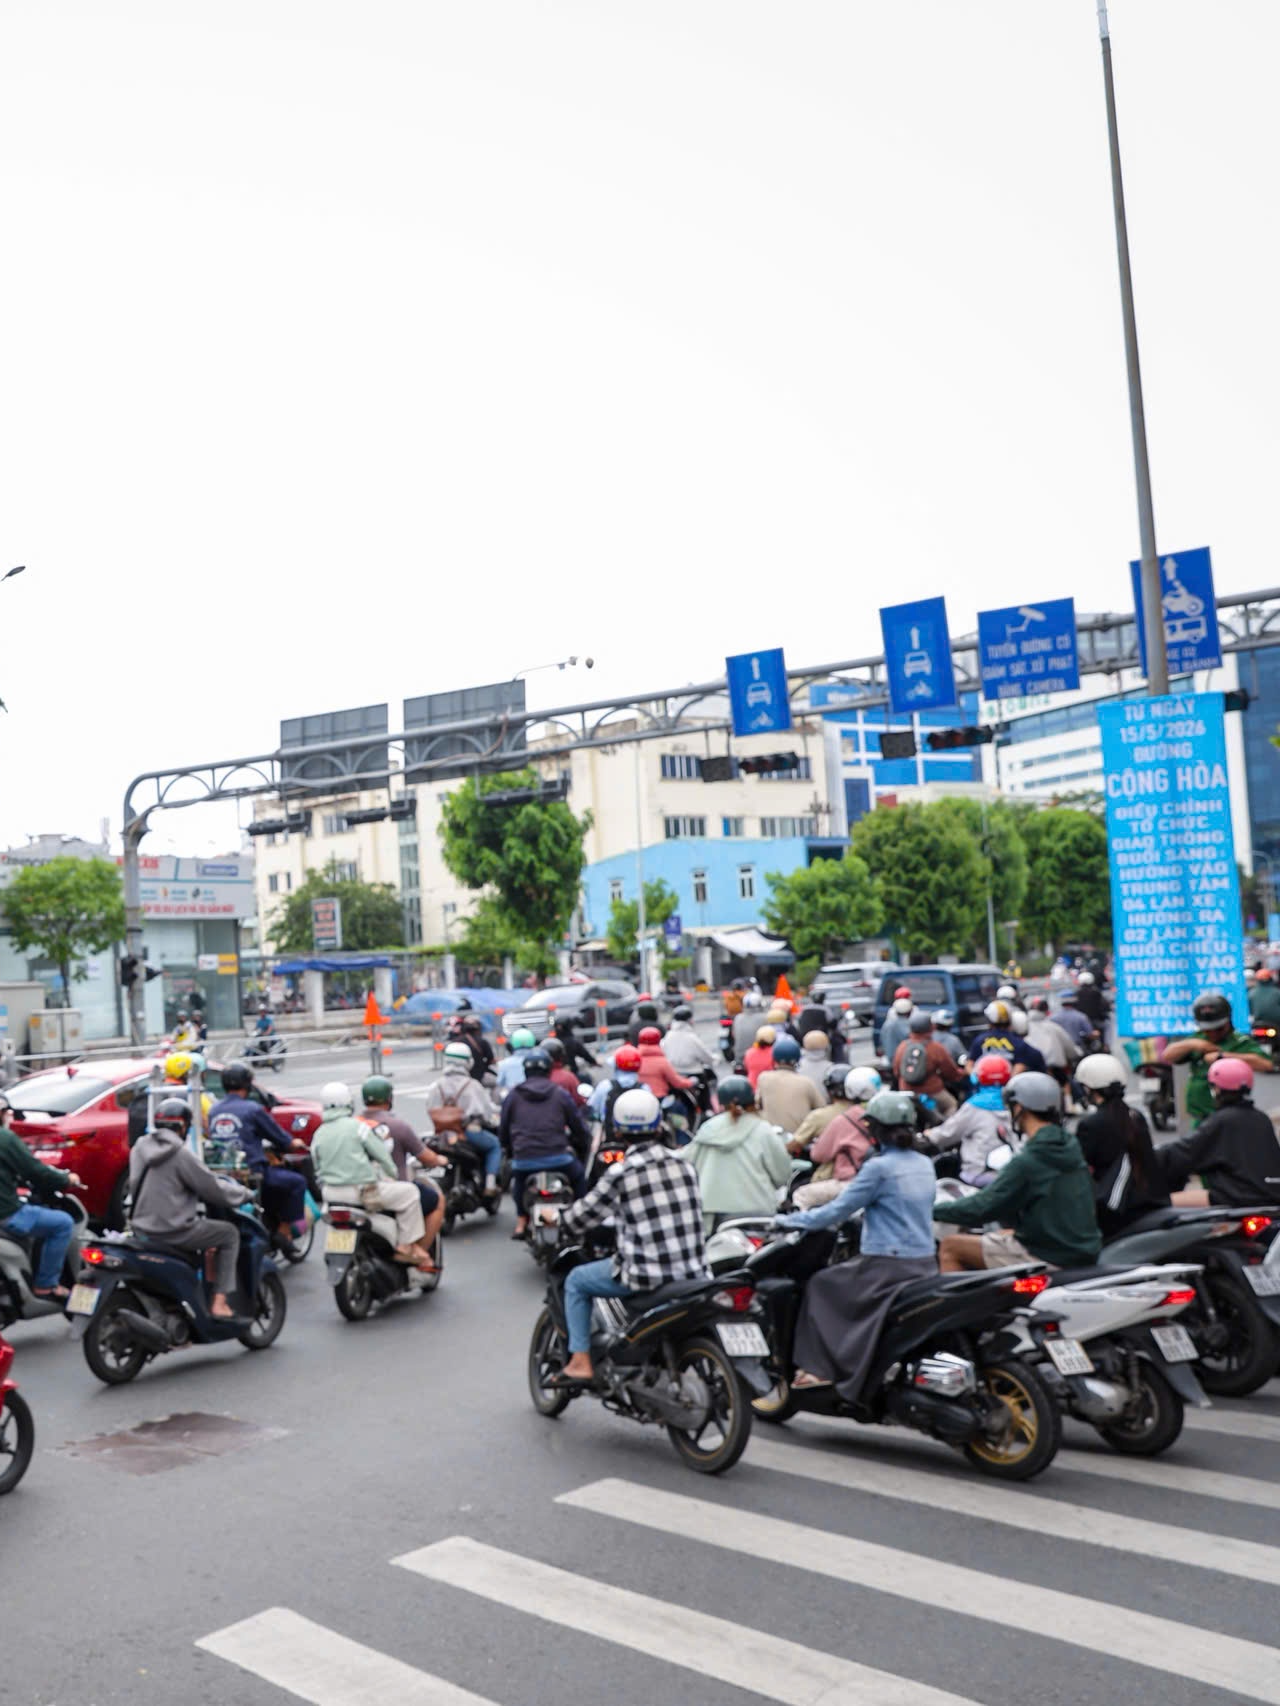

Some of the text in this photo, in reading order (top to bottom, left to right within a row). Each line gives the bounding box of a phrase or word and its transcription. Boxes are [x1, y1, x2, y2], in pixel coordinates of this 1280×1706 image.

[1120, 719, 1207, 744] 15/5/2026
[1107, 759, 1228, 802] CỘNG HÒA
